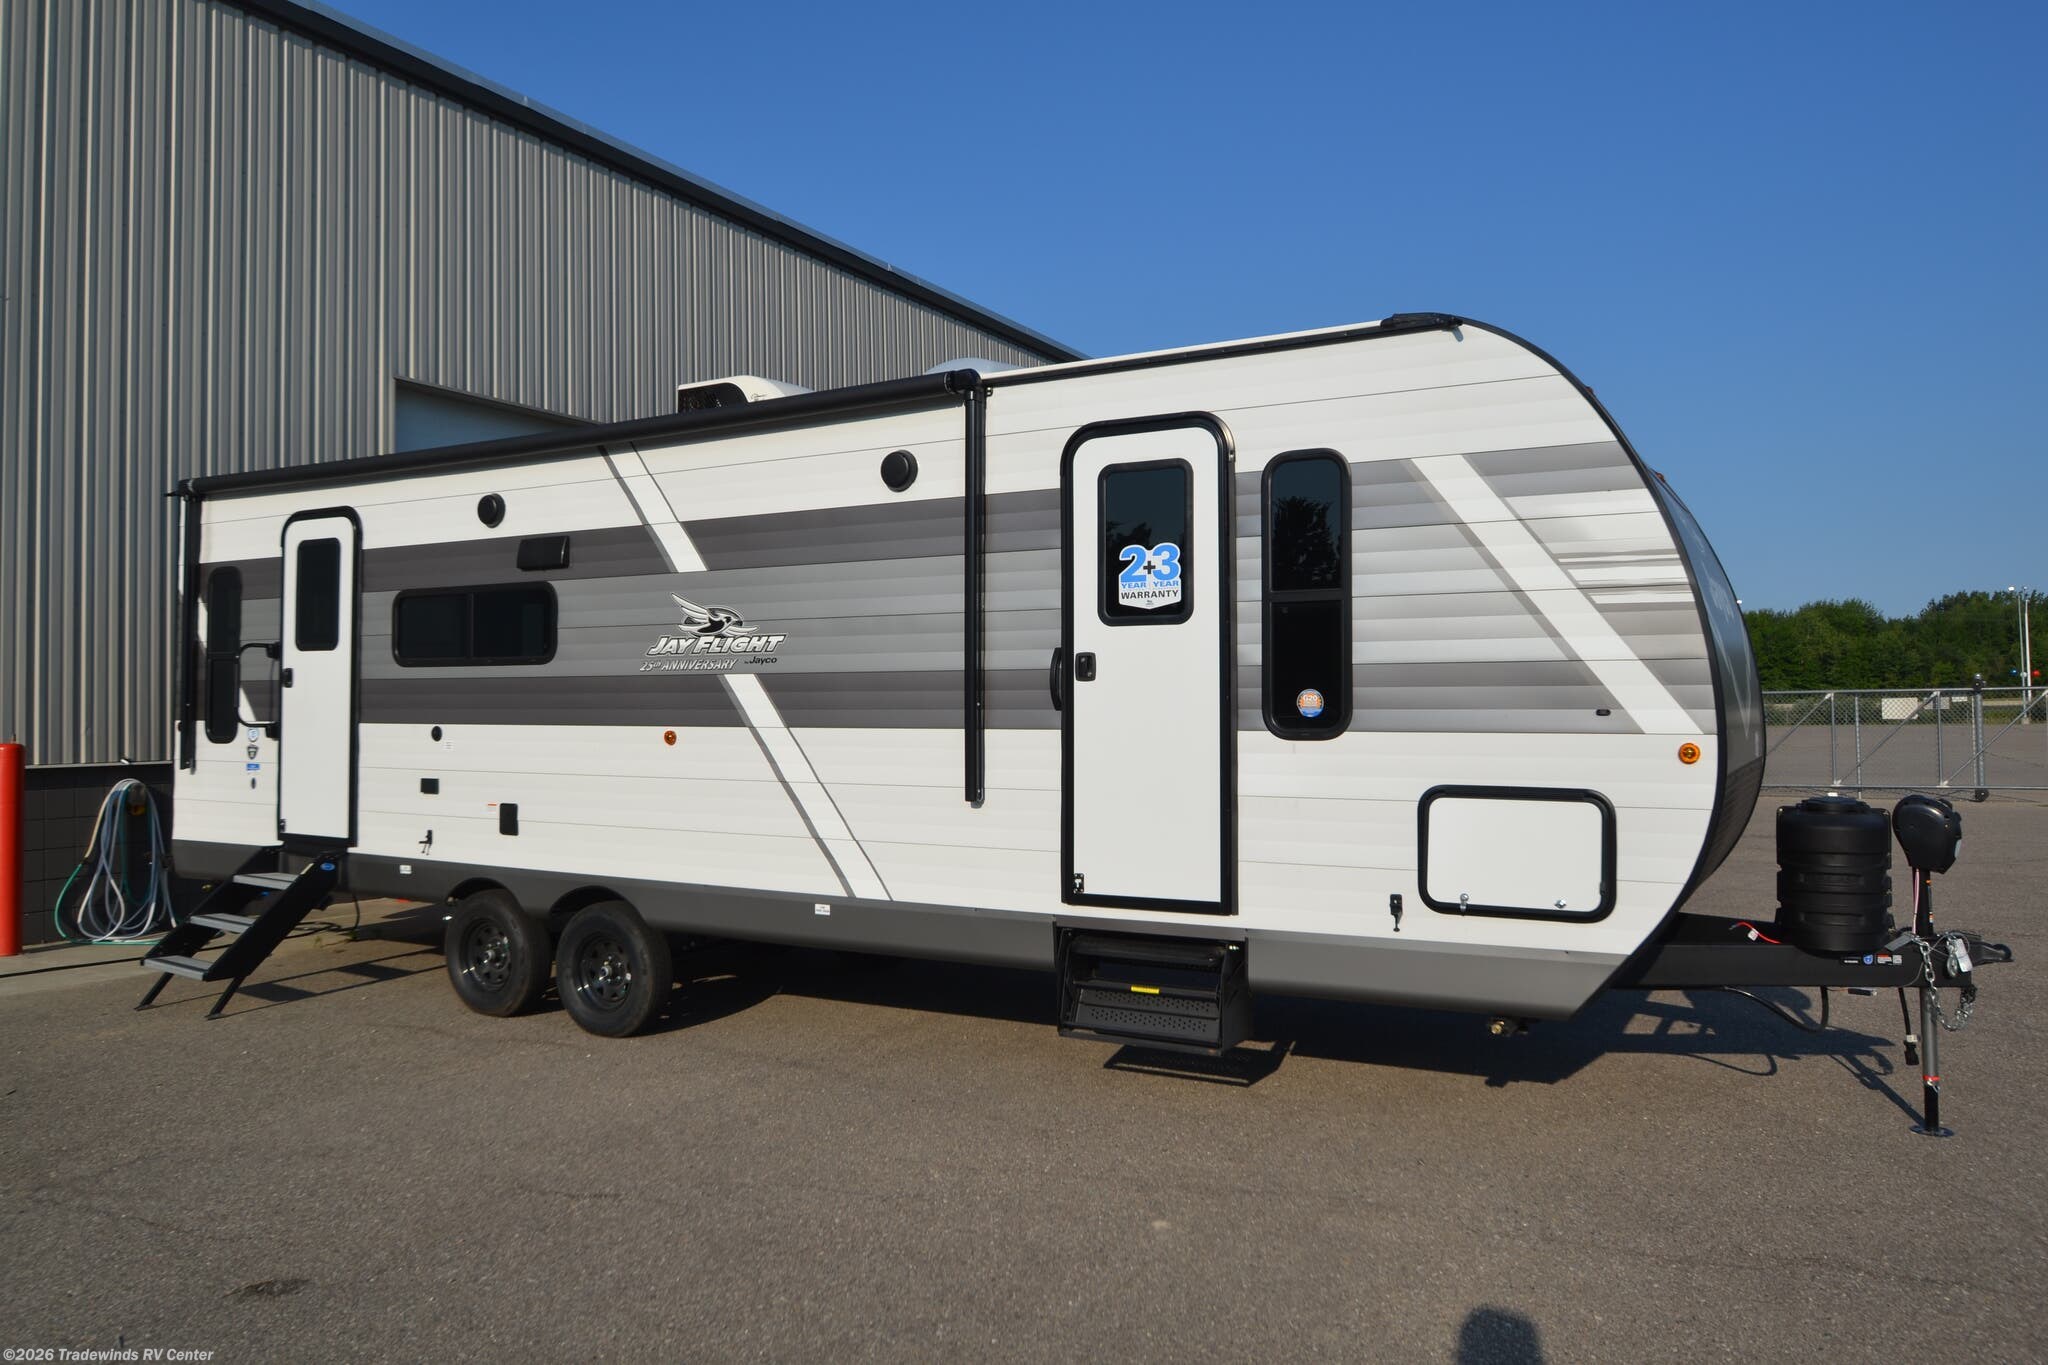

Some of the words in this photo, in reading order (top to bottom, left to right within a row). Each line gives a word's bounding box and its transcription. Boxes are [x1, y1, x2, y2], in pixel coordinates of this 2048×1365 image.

[1153, 580, 1179, 588] YEAR
[1121, 590, 1179, 600] WARRANTY
[647, 635, 697, 656] JAY
[692, 634, 787, 655] FLIGHT
[640, 659, 661, 671] 25th
[661, 658, 738, 671] ANNIVERSARY
[749, 656, 777, 665] Jayco
